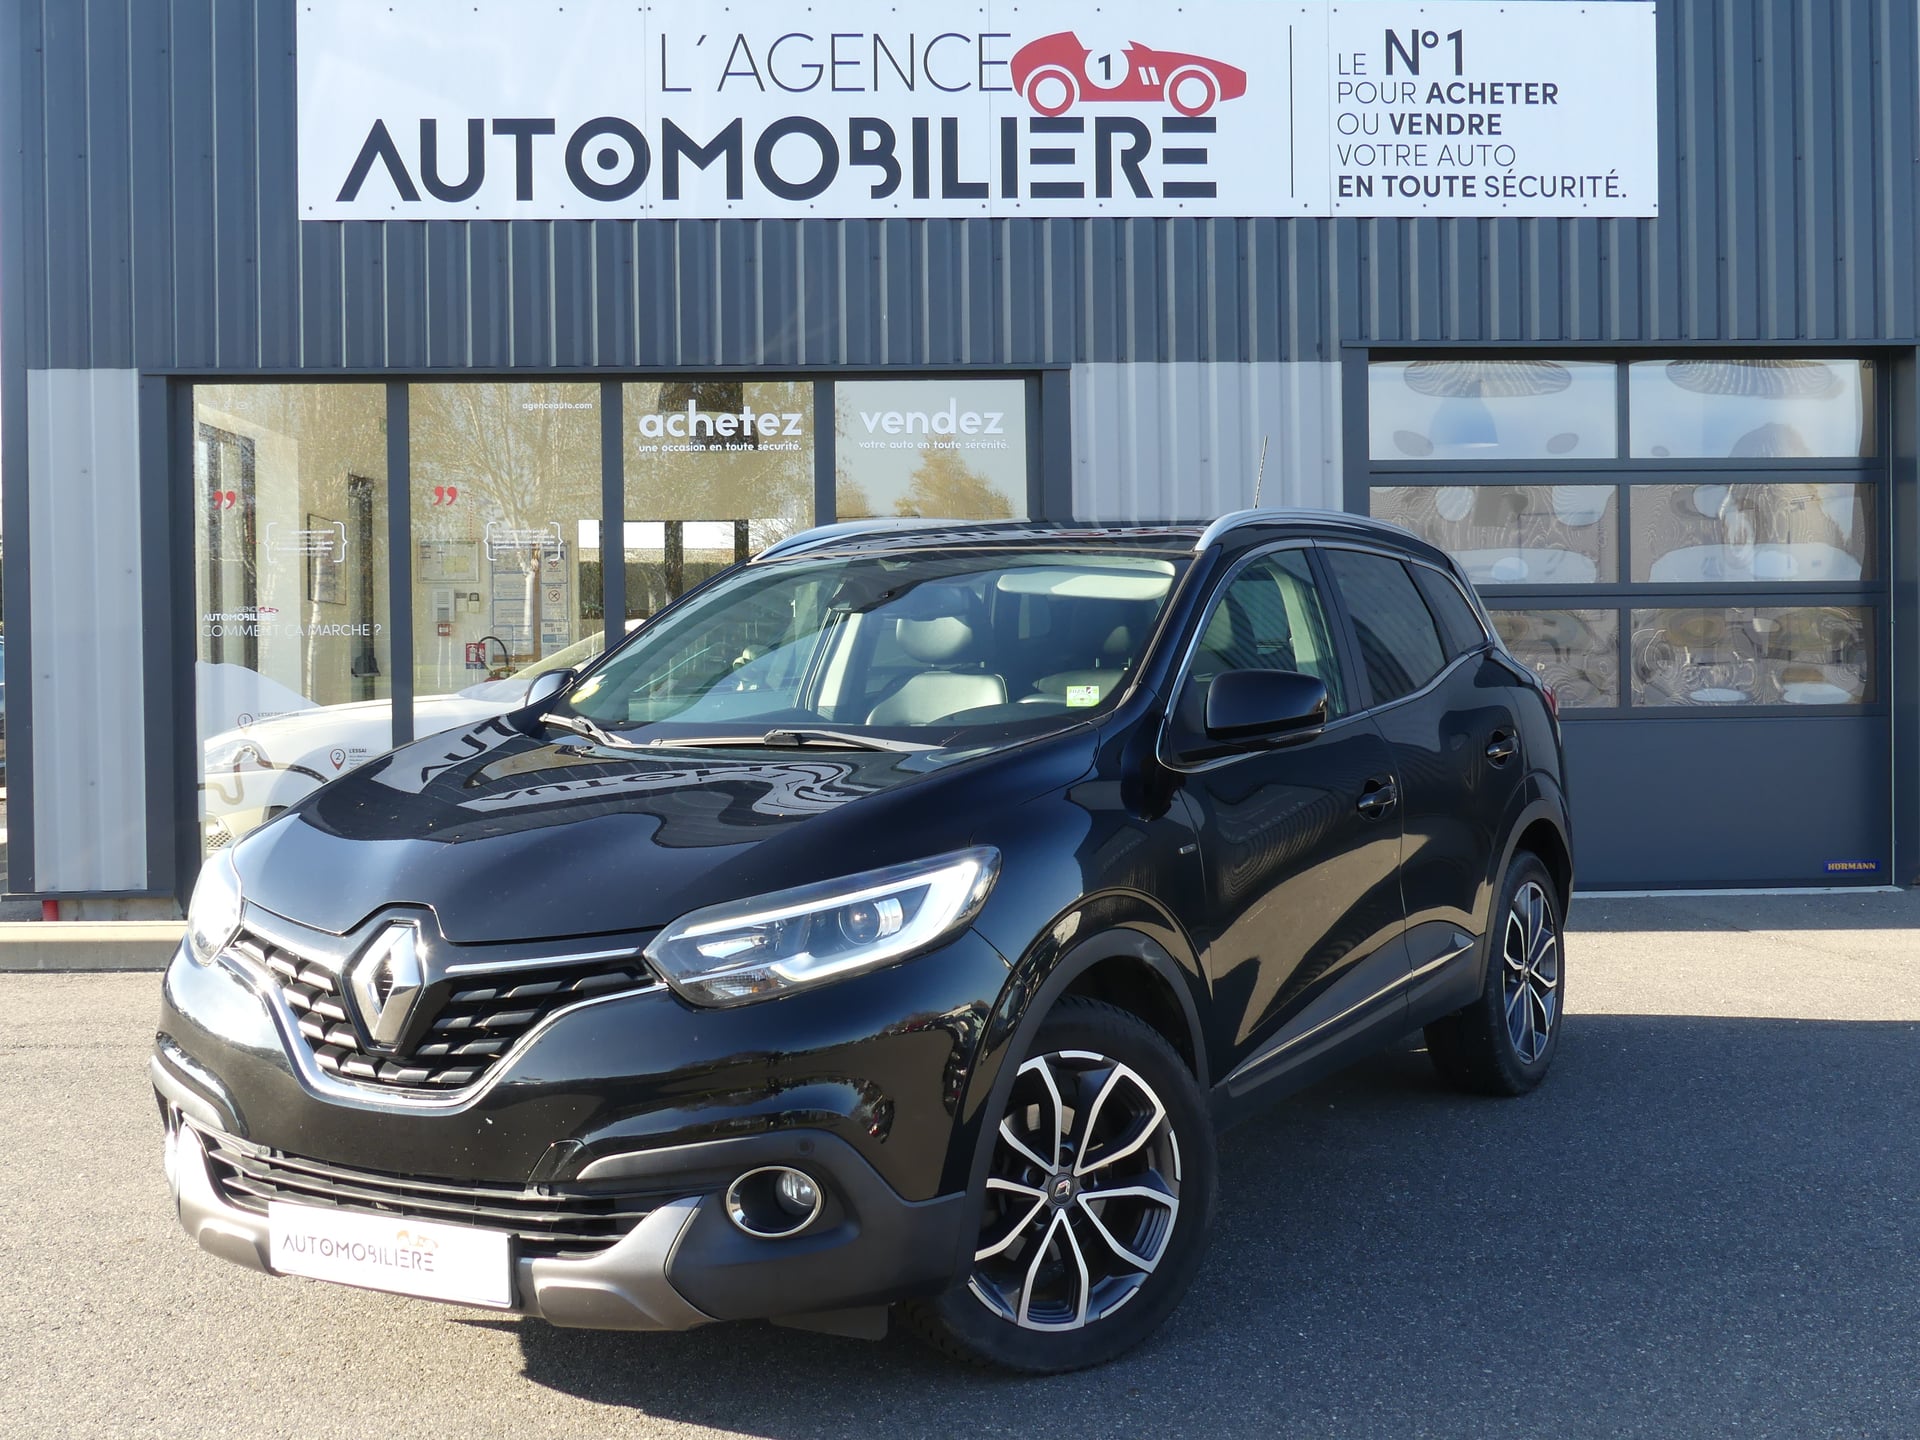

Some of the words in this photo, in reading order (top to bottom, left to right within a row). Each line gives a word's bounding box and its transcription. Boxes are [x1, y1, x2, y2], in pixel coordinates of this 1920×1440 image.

[661, 33, 1012, 92] L'AGENCE
[1098, 53, 1113, 81] 1
[1338, 53, 1367, 75] LE
[1338, 81, 1416, 104] POUR
[1425, 82, 1559, 105] ACHETER
[1337, 112, 1379, 136] OU
[1389, 113, 1502, 136] VENDRE
[335, 115, 1217, 202] AUTOMOBILIERE
[1337, 144, 1428, 167] VOTRE
[1437, 144, 1516, 167] AUTO
[1338, 175, 1373, 198] EN
[1381, 175, 1477, 198] TOUTE
[1484, 168, 1627, 198] SÉCURITÉ.
[522, 402, 593, 411] agenceauto.com
[639, 399, 803, 437] achetez
[859, 397, 1005, 434] vendez
[639, 444, 658, 452] une
[661, 442, 706, 452] occasion
[709, 444, 722, 452] en
[725, 442, 754, 451] toute
[757, 440, 802, 451] sécurité.
[859, 441, 886, 449] votre
[889, 441, 914, 449] auto
[934, 441, 961, 449] toute
[308, 624, 370, 636] MARCHE
[374, 624, 382, 636] ?
[335, 751, 341, 760] 2
[283, 1234, 435, 1272] AUTOMOBILIERE
